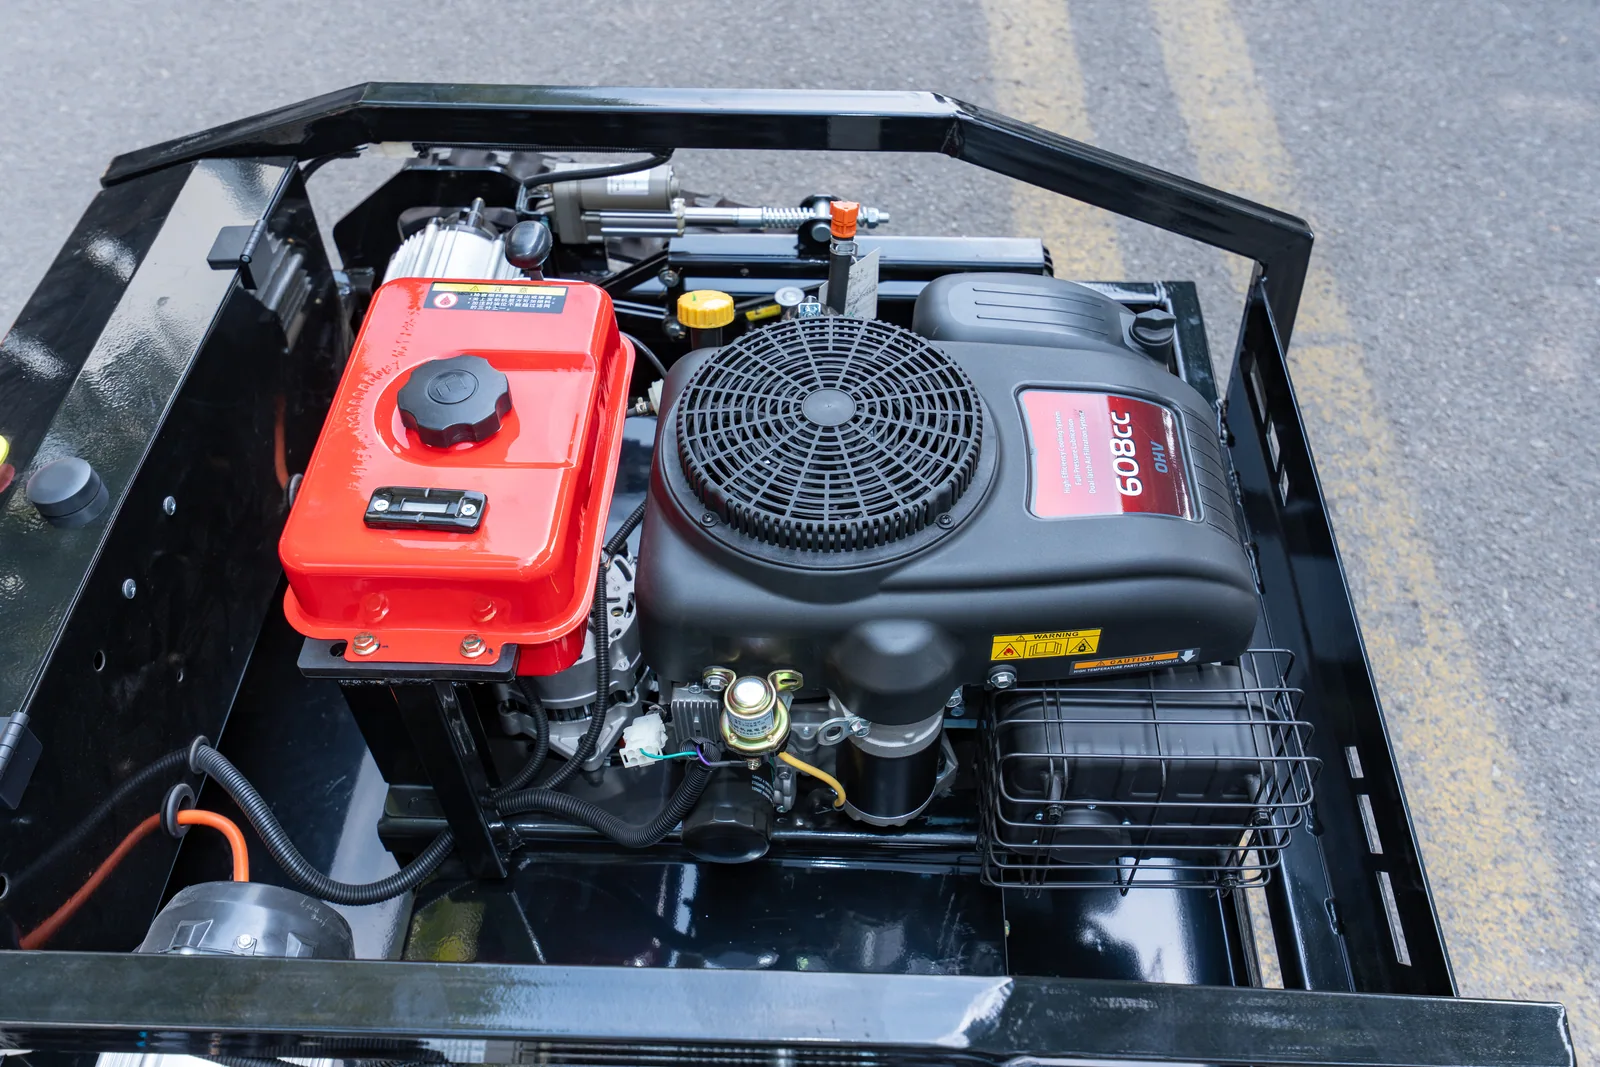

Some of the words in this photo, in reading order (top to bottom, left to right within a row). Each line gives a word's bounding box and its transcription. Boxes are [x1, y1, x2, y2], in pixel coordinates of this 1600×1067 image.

[1055, 411, 1063, 430] System
[1057, 430, 1065, 451] Cooling
[1068, 418, 1077, 449] Lubrication
[1082, 430, 1090, 456] Filtration
[1084, 456, 1092, 464] Air
[1109, 410, 1143, 496] 608cc
[1150, 440, 1168, 473] OHV
[1060, 452, 1071, 494] High-Efficiency
[1072, 449, 1082, 486] Full-Pressure
[1033, 632, 1079, 640] WARNING
[1087, 665, 1122, 673] TEMPERATURE
[1110, 655, 1155, 665] CAUTION
